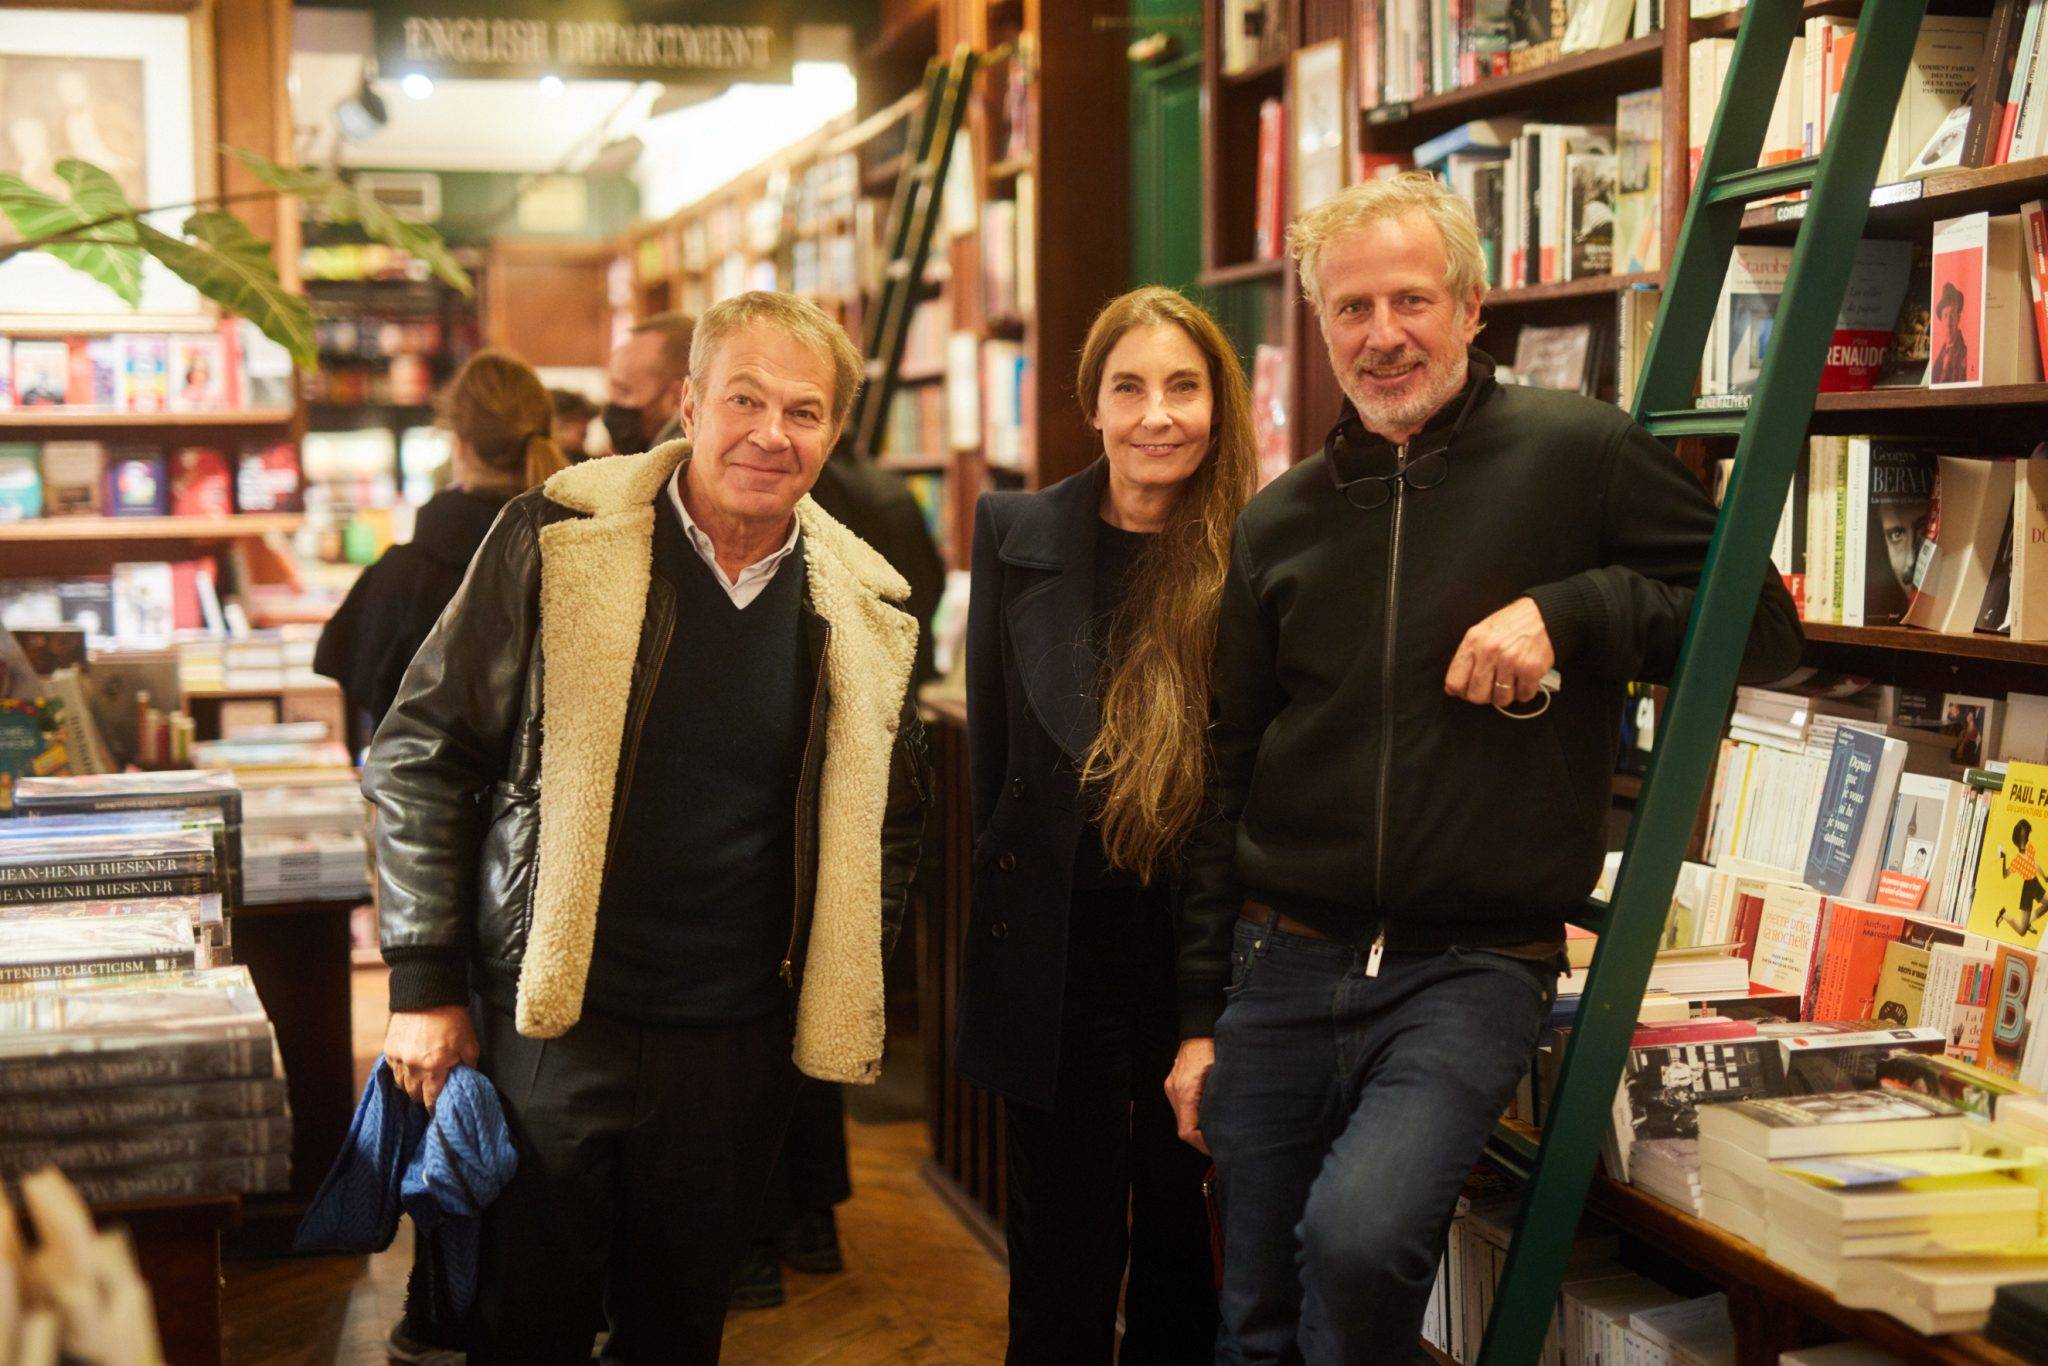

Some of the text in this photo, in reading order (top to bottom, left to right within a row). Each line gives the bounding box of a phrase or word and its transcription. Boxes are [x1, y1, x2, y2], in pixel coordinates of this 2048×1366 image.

[403, 17, 776, 67] ENGLISH DEPARTMENT
[1849, 755, 1872, 773] Depuis
[2009, 784, 2034, 805] PAUL
[100, 859, 177, 875] RIESENER
[0, 881, 173, 902] EAN-HENRI RIESENER
[55, 961, 145, 977] ECLECTICISM
